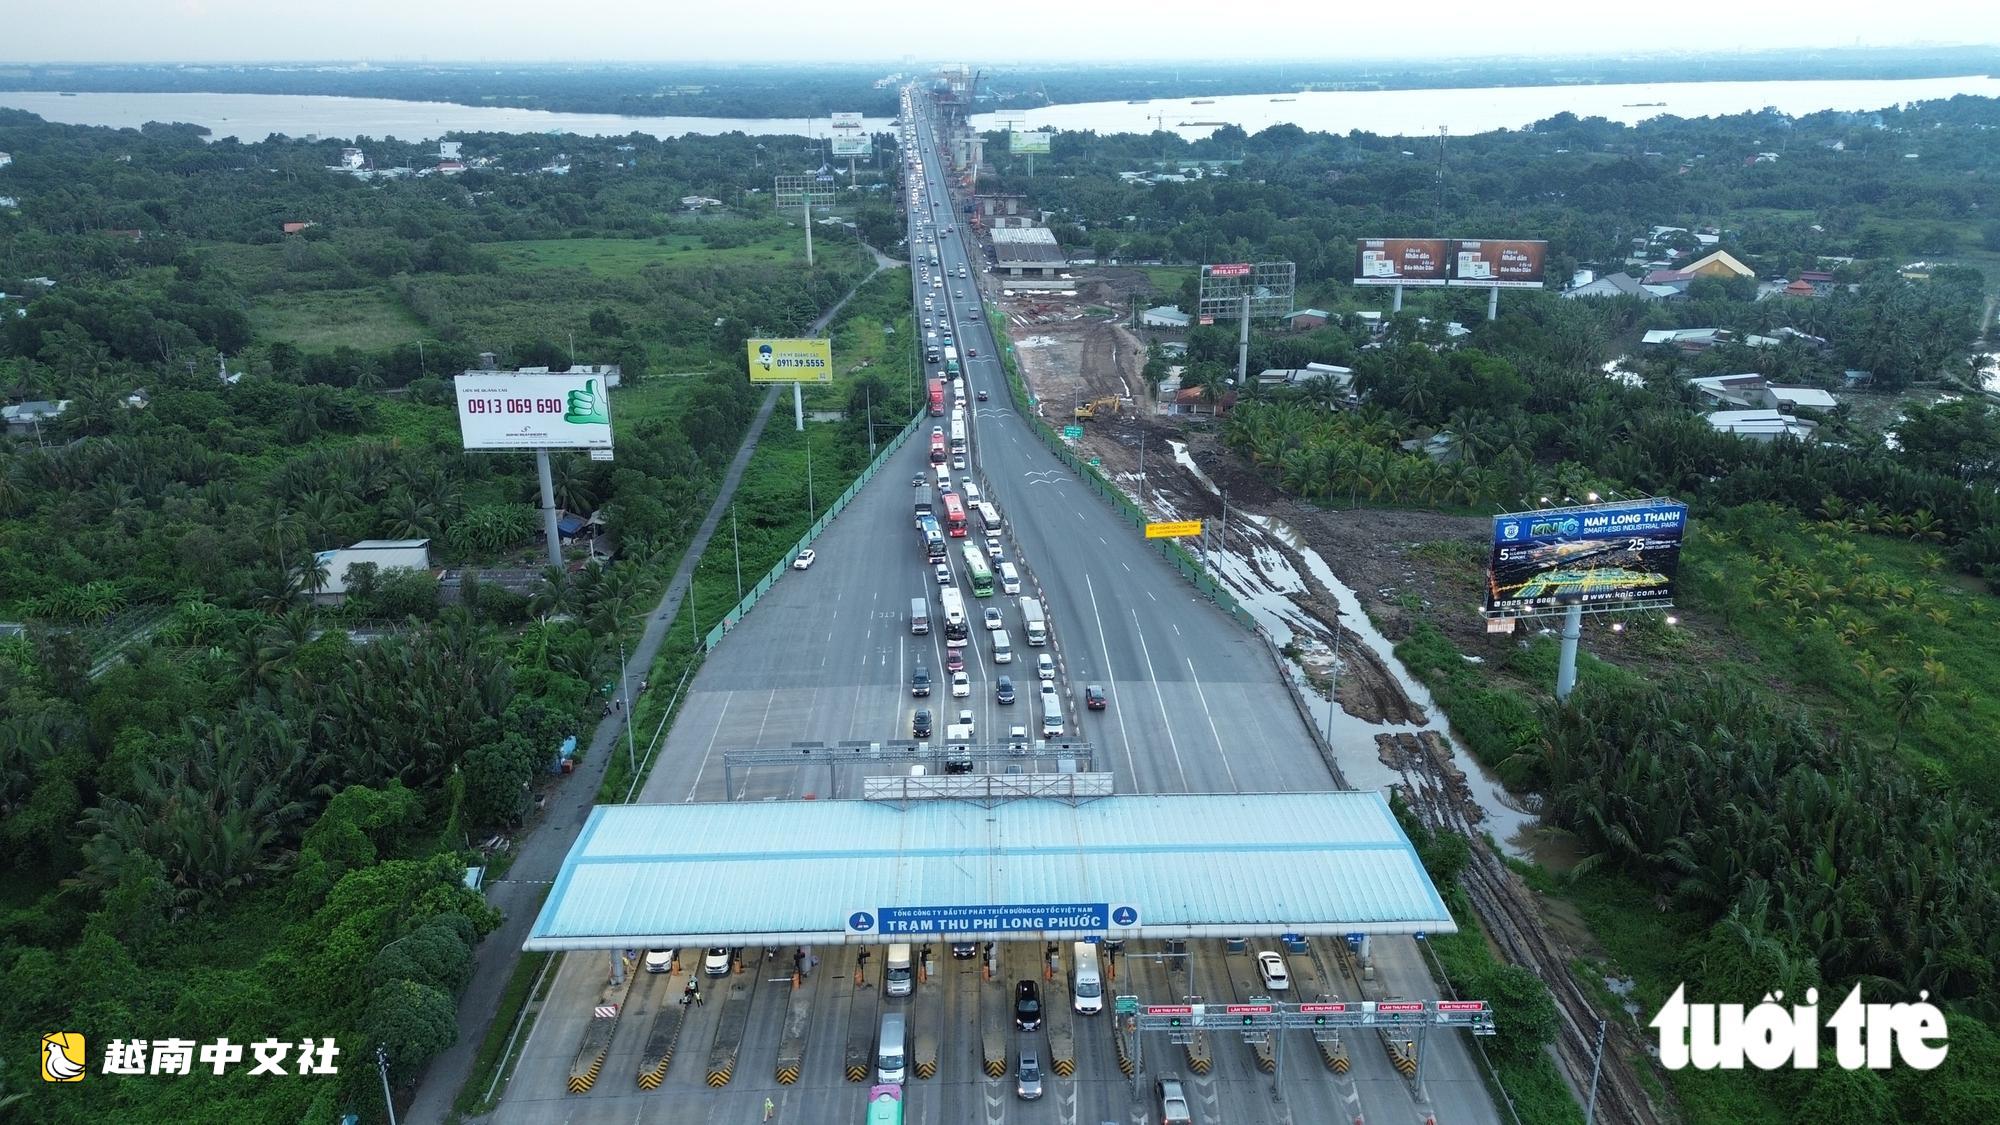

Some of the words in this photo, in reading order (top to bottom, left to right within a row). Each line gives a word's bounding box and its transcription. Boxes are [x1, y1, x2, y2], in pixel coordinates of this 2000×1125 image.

[468, 399, 502, 413] 0913
[507, 399, 532, 413] 069
[537, 399, 562, 413] 690
[1584, 516, 1608, 527] NAM
[1611, 514, 1641, 525] LONG
[1644, 511, 1680, 522] THANH
[1584, 525, 1621, 534] SMART-ESG
[1623, 523, 1659, 531] INDUSTRIAL
[1627, 538, 1645, 551] 25
[1500, 548, 1509, 561] 5
[1590, 589, 1668, 600] www.knic.com.vn
[893, 909, 912, 917] TỔNG
[988, 906, 1010, 915] TRIỂN
[1046, 905, 1060, 914] TỐC
[1061, 906, 1076, 914] VIỆT
[888, 920, 933, 933] TRẠM
[938, 919, 969, 930] THU
[973, 915, 998, 929] PHÍ
[1002, 918, 1044, 928] LONG
[1048, 913, 1101, 928] PHƯỚC
